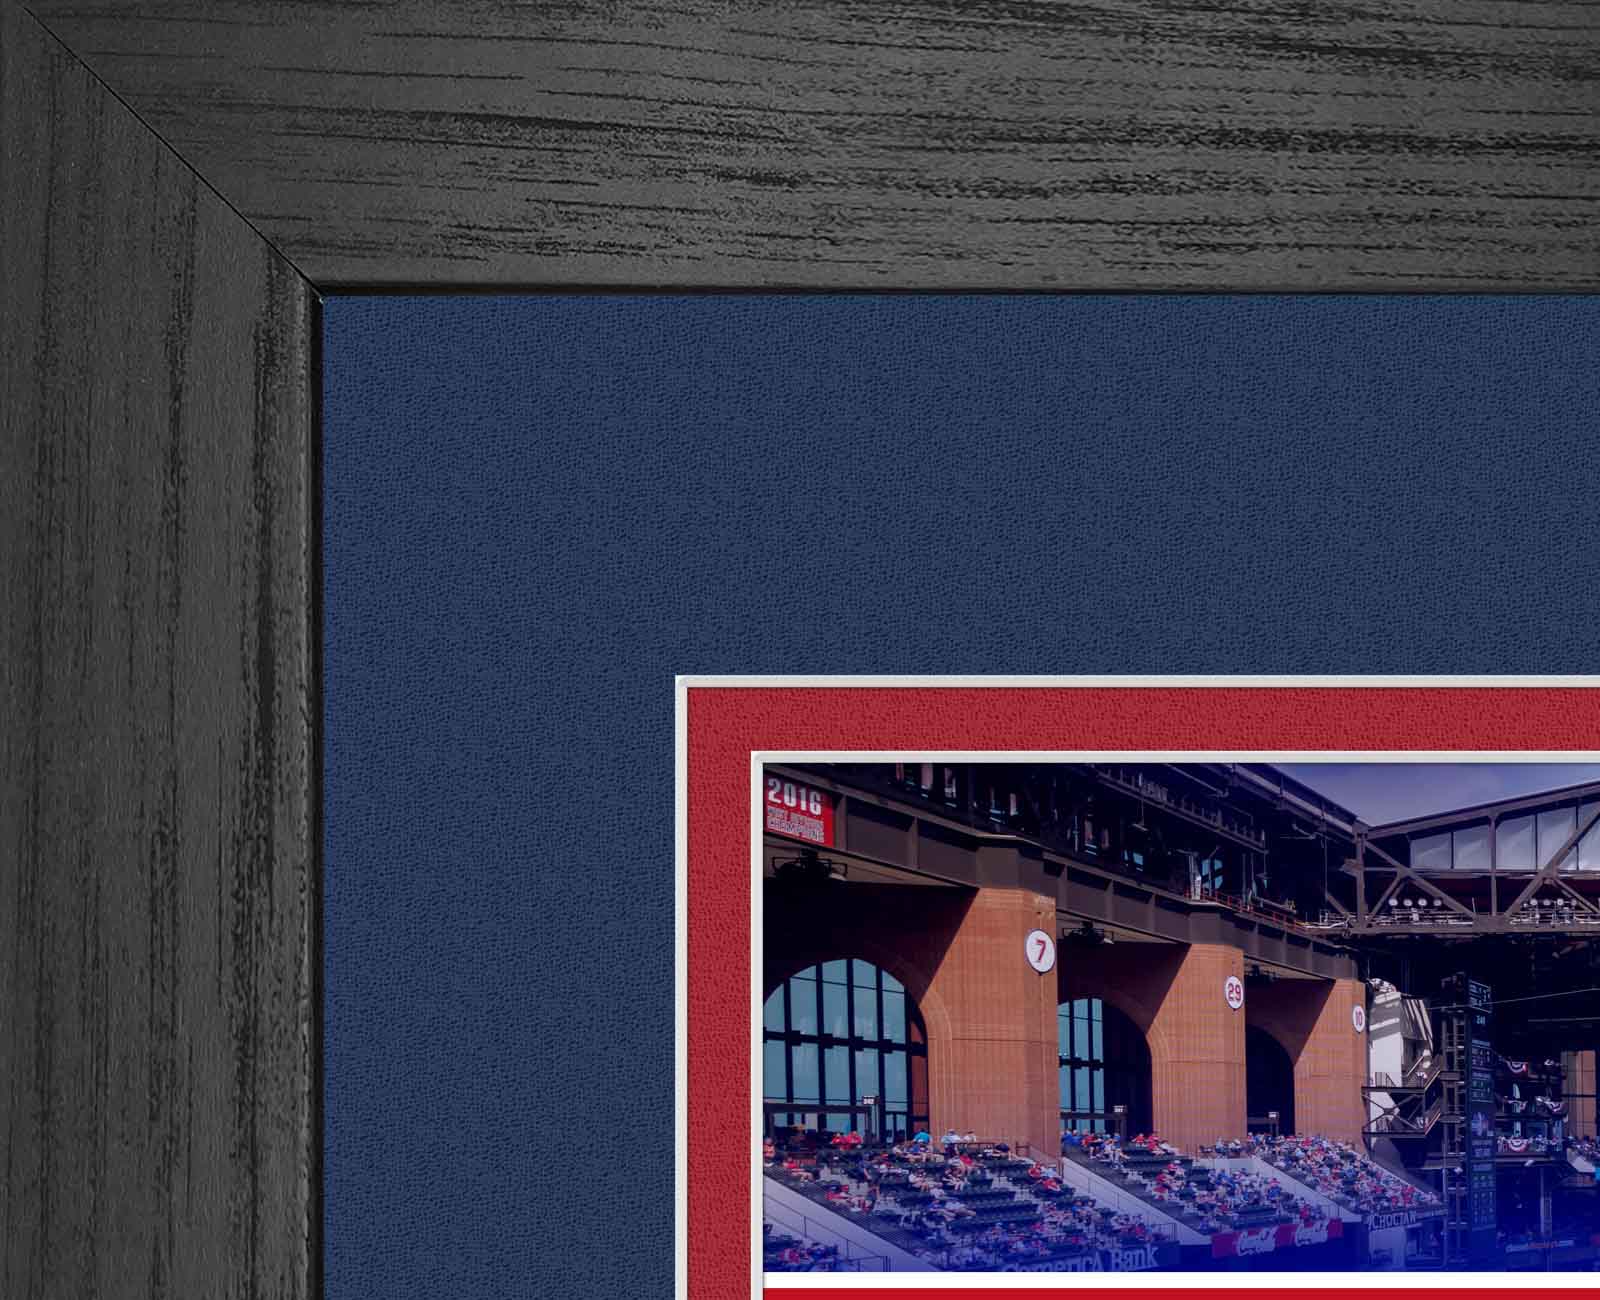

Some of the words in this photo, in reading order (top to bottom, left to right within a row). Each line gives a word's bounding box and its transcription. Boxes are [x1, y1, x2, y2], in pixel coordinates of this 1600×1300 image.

[768, 778, 821, 816] 2016
[1035, 939, 1047, 964] 7
[1227, 982, 1242, 1003] 29
[1354, 1011, 1363, 1028] 10
[1112, 1246, 1158, 1269] Bank
